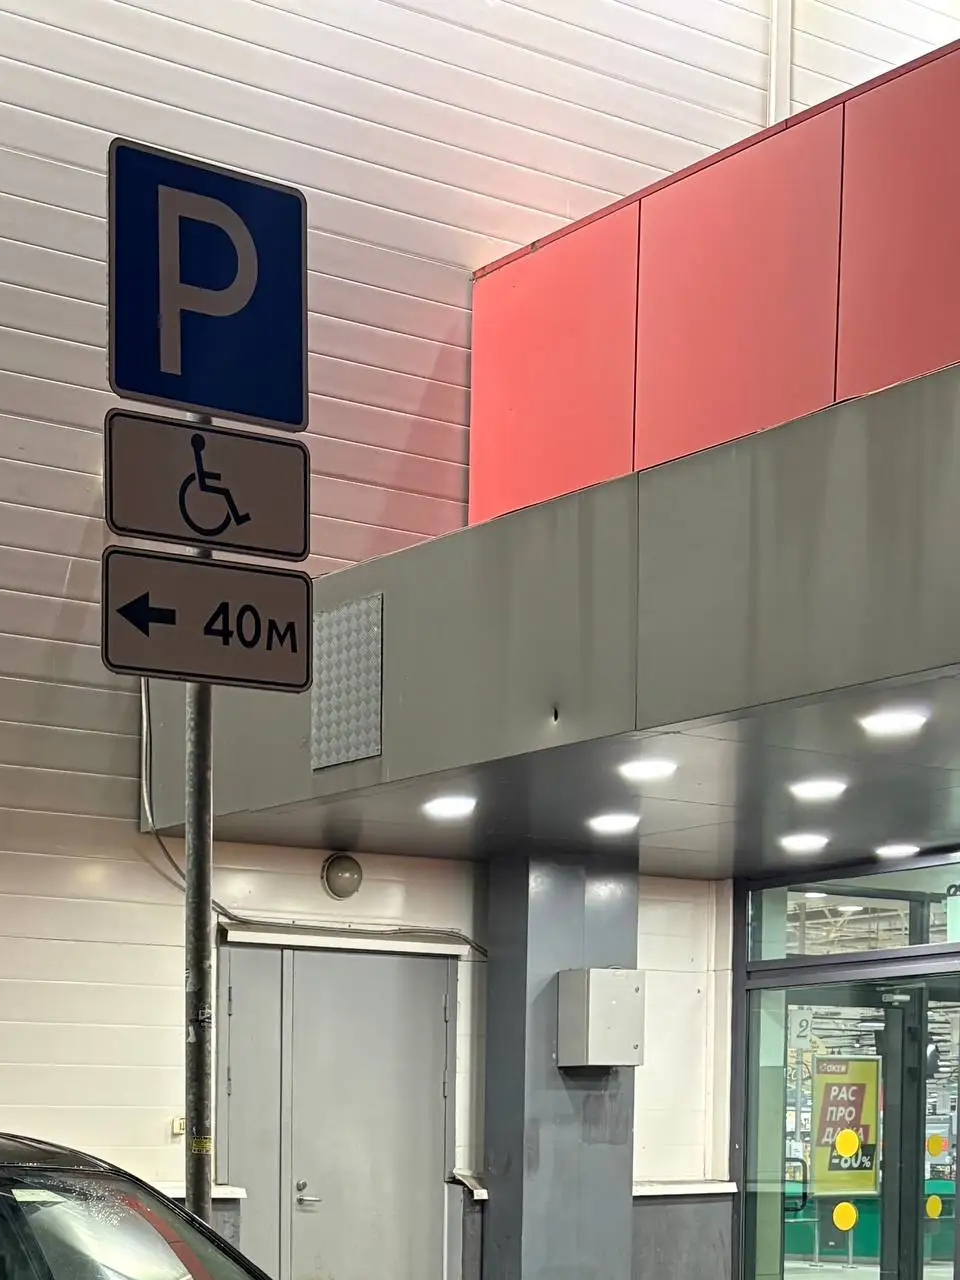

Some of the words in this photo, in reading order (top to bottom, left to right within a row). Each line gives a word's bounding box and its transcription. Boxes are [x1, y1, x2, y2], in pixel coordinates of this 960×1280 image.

[157, 184, 258, 375] P
[796, 1018, 810, 1039] 2
[830, 1086, 858, 1101] РАС
[826, 1106, 856, 1122] ПРО
[821, 1127, 864, 1144] ДА
